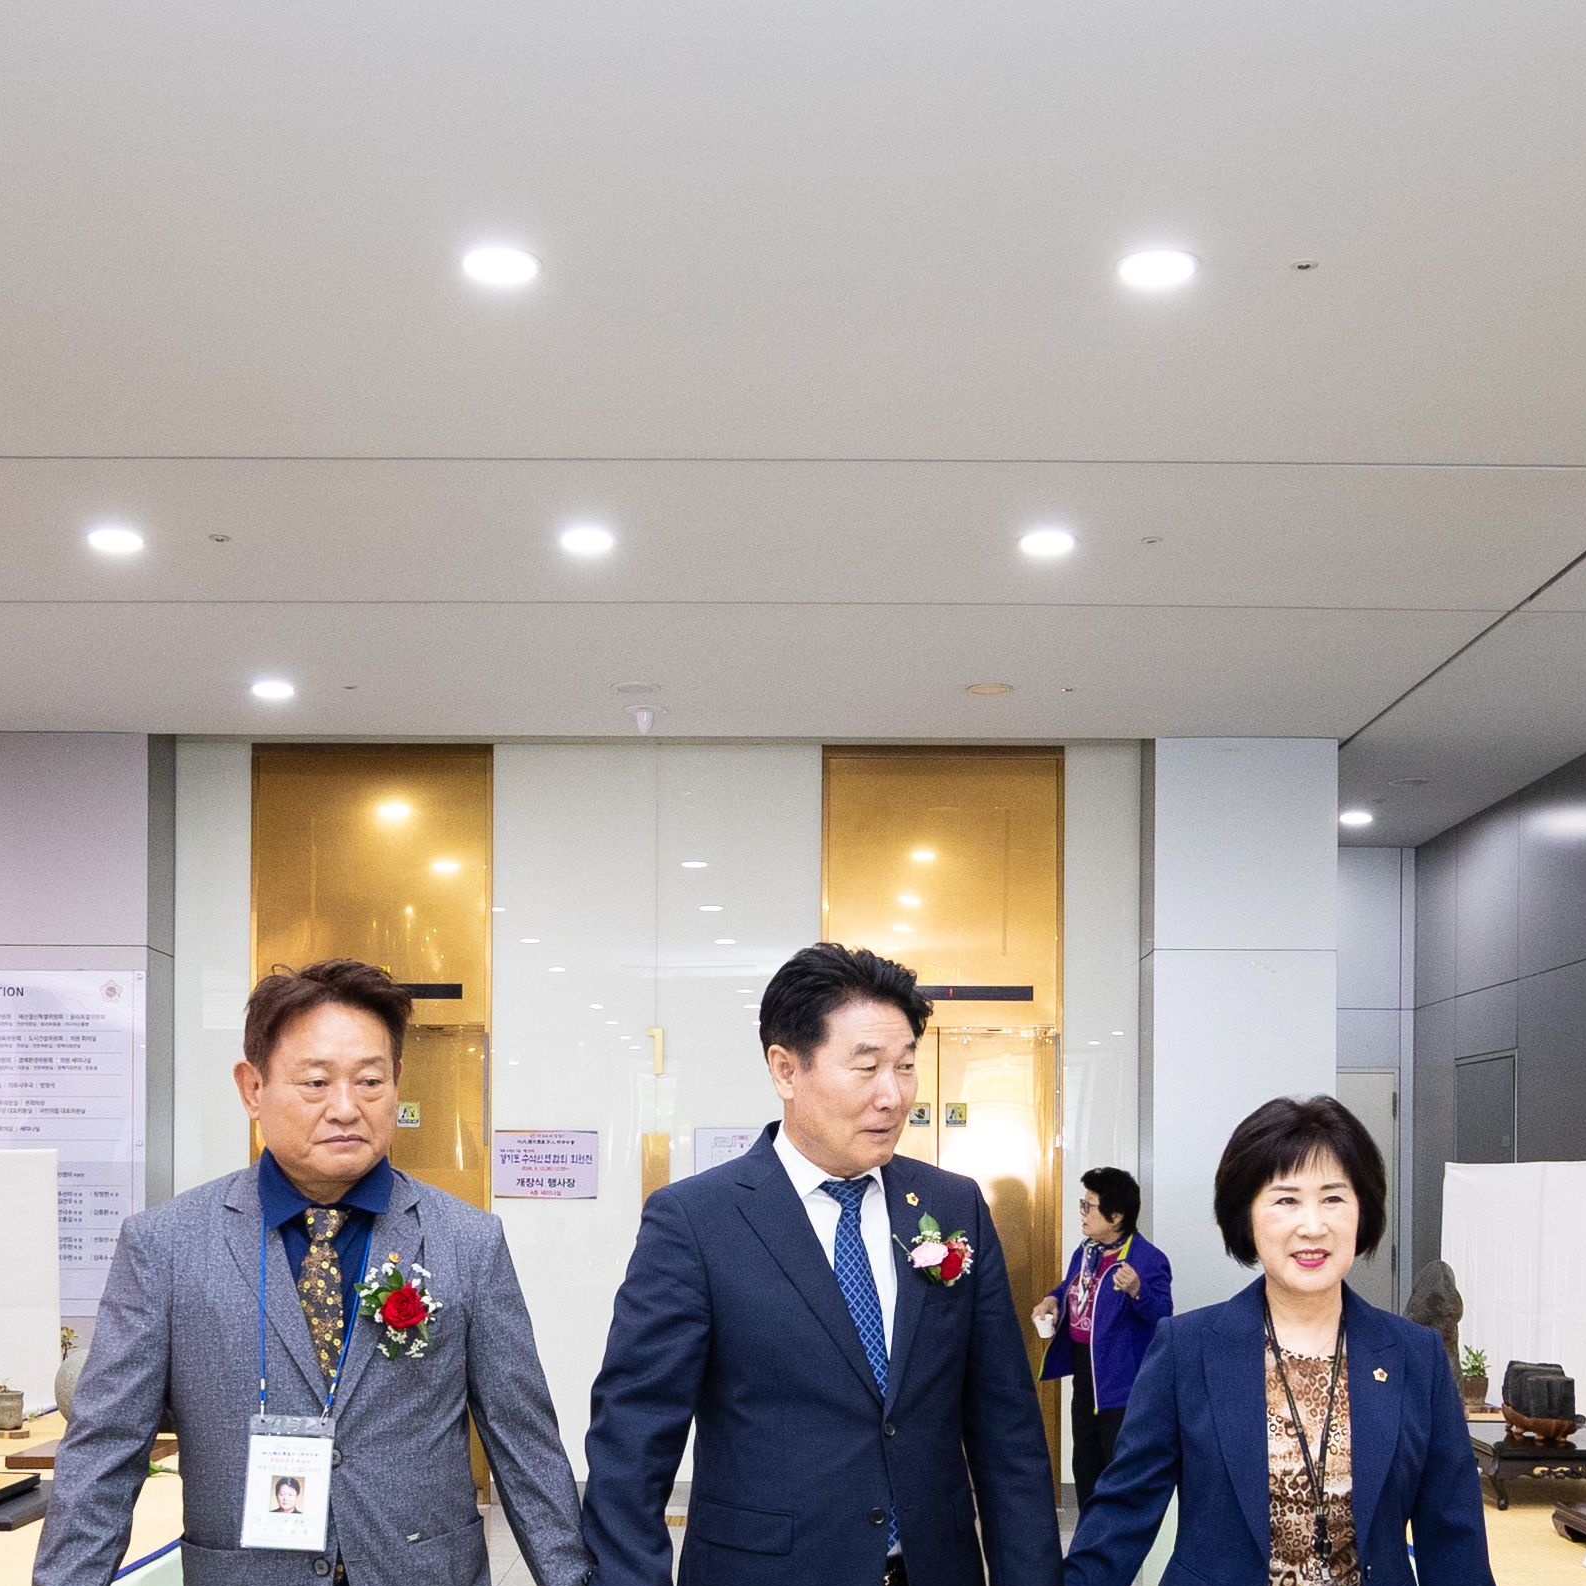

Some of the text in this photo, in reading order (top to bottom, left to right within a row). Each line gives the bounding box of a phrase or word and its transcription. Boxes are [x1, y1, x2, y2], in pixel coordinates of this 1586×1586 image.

[646, 1027, 664, 1076] 1
[499, 1154, 521, 1165] 경기도
[570, 1153, 593, 1165] 회원전
[516, 1177, 576, 1189] 개장식 행사장
